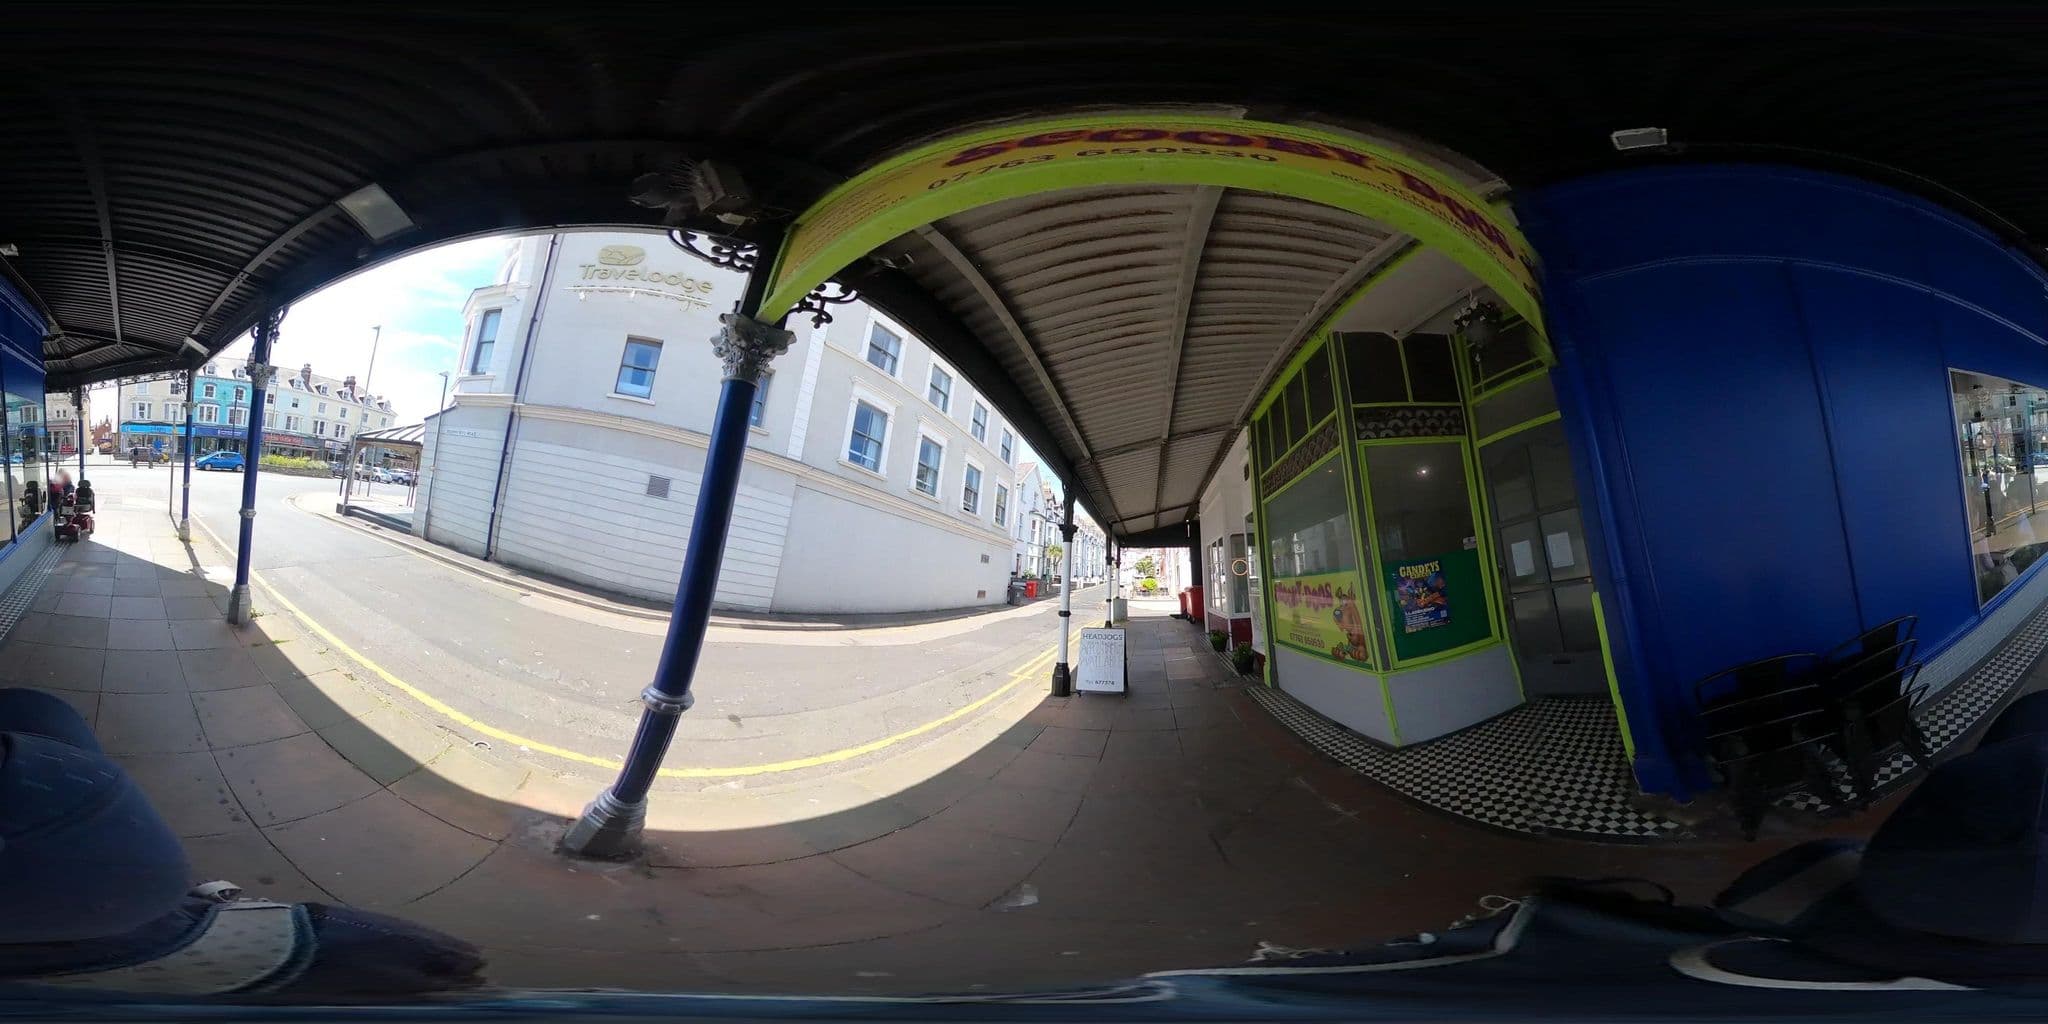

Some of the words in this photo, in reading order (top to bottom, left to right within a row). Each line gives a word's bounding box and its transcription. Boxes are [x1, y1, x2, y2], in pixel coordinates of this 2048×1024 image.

[927, 153, 1057, 191] 07763
[1076, 146, 1279, 163] 650530
[579, 263, 714, 293] Travelodge
[1399, 561, 1440, 577] GANDEYS
